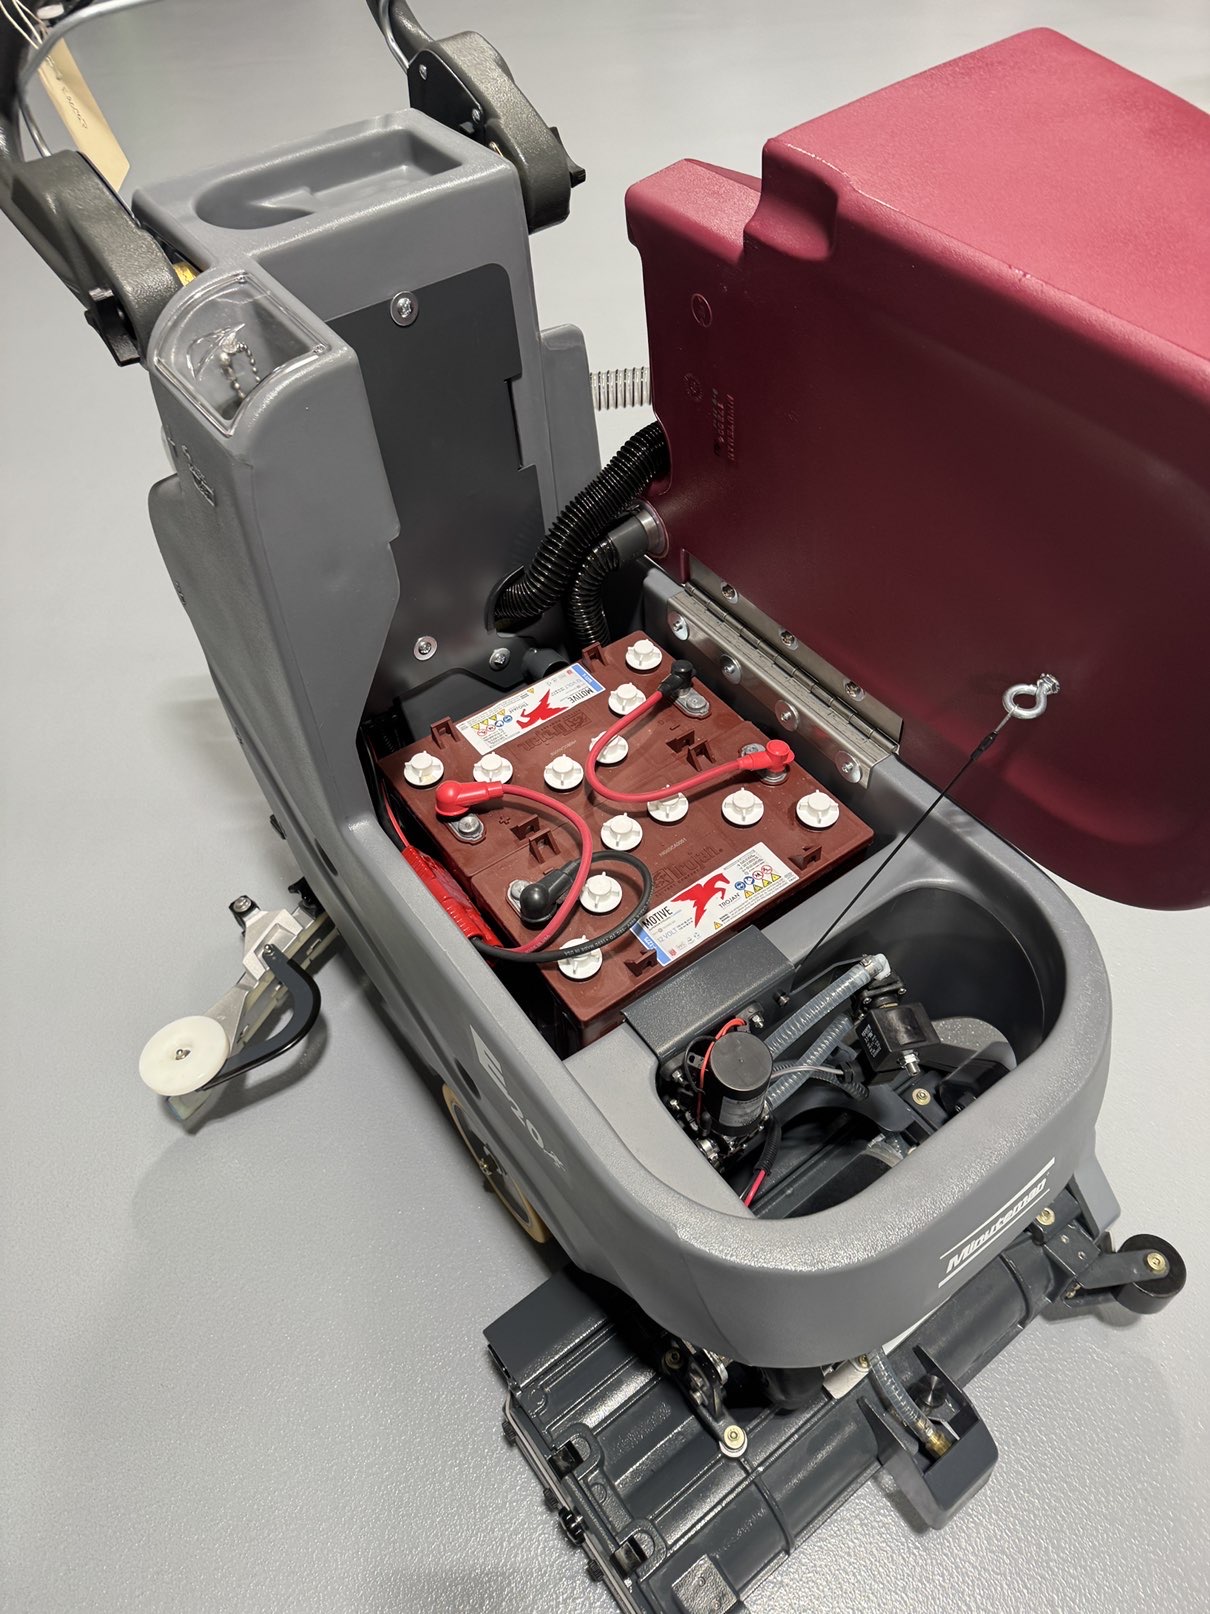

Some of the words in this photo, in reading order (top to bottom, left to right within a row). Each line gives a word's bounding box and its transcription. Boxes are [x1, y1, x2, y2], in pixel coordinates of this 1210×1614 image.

[568, 687, 594, 704] MOTIVE
[718, 892, 740, 908] TROJAN
[641, 906, 673, 929] MOTIVE
[663, 927, 678, 940] VOLT
[946, 1178, 1047, 1274] Minuteman
